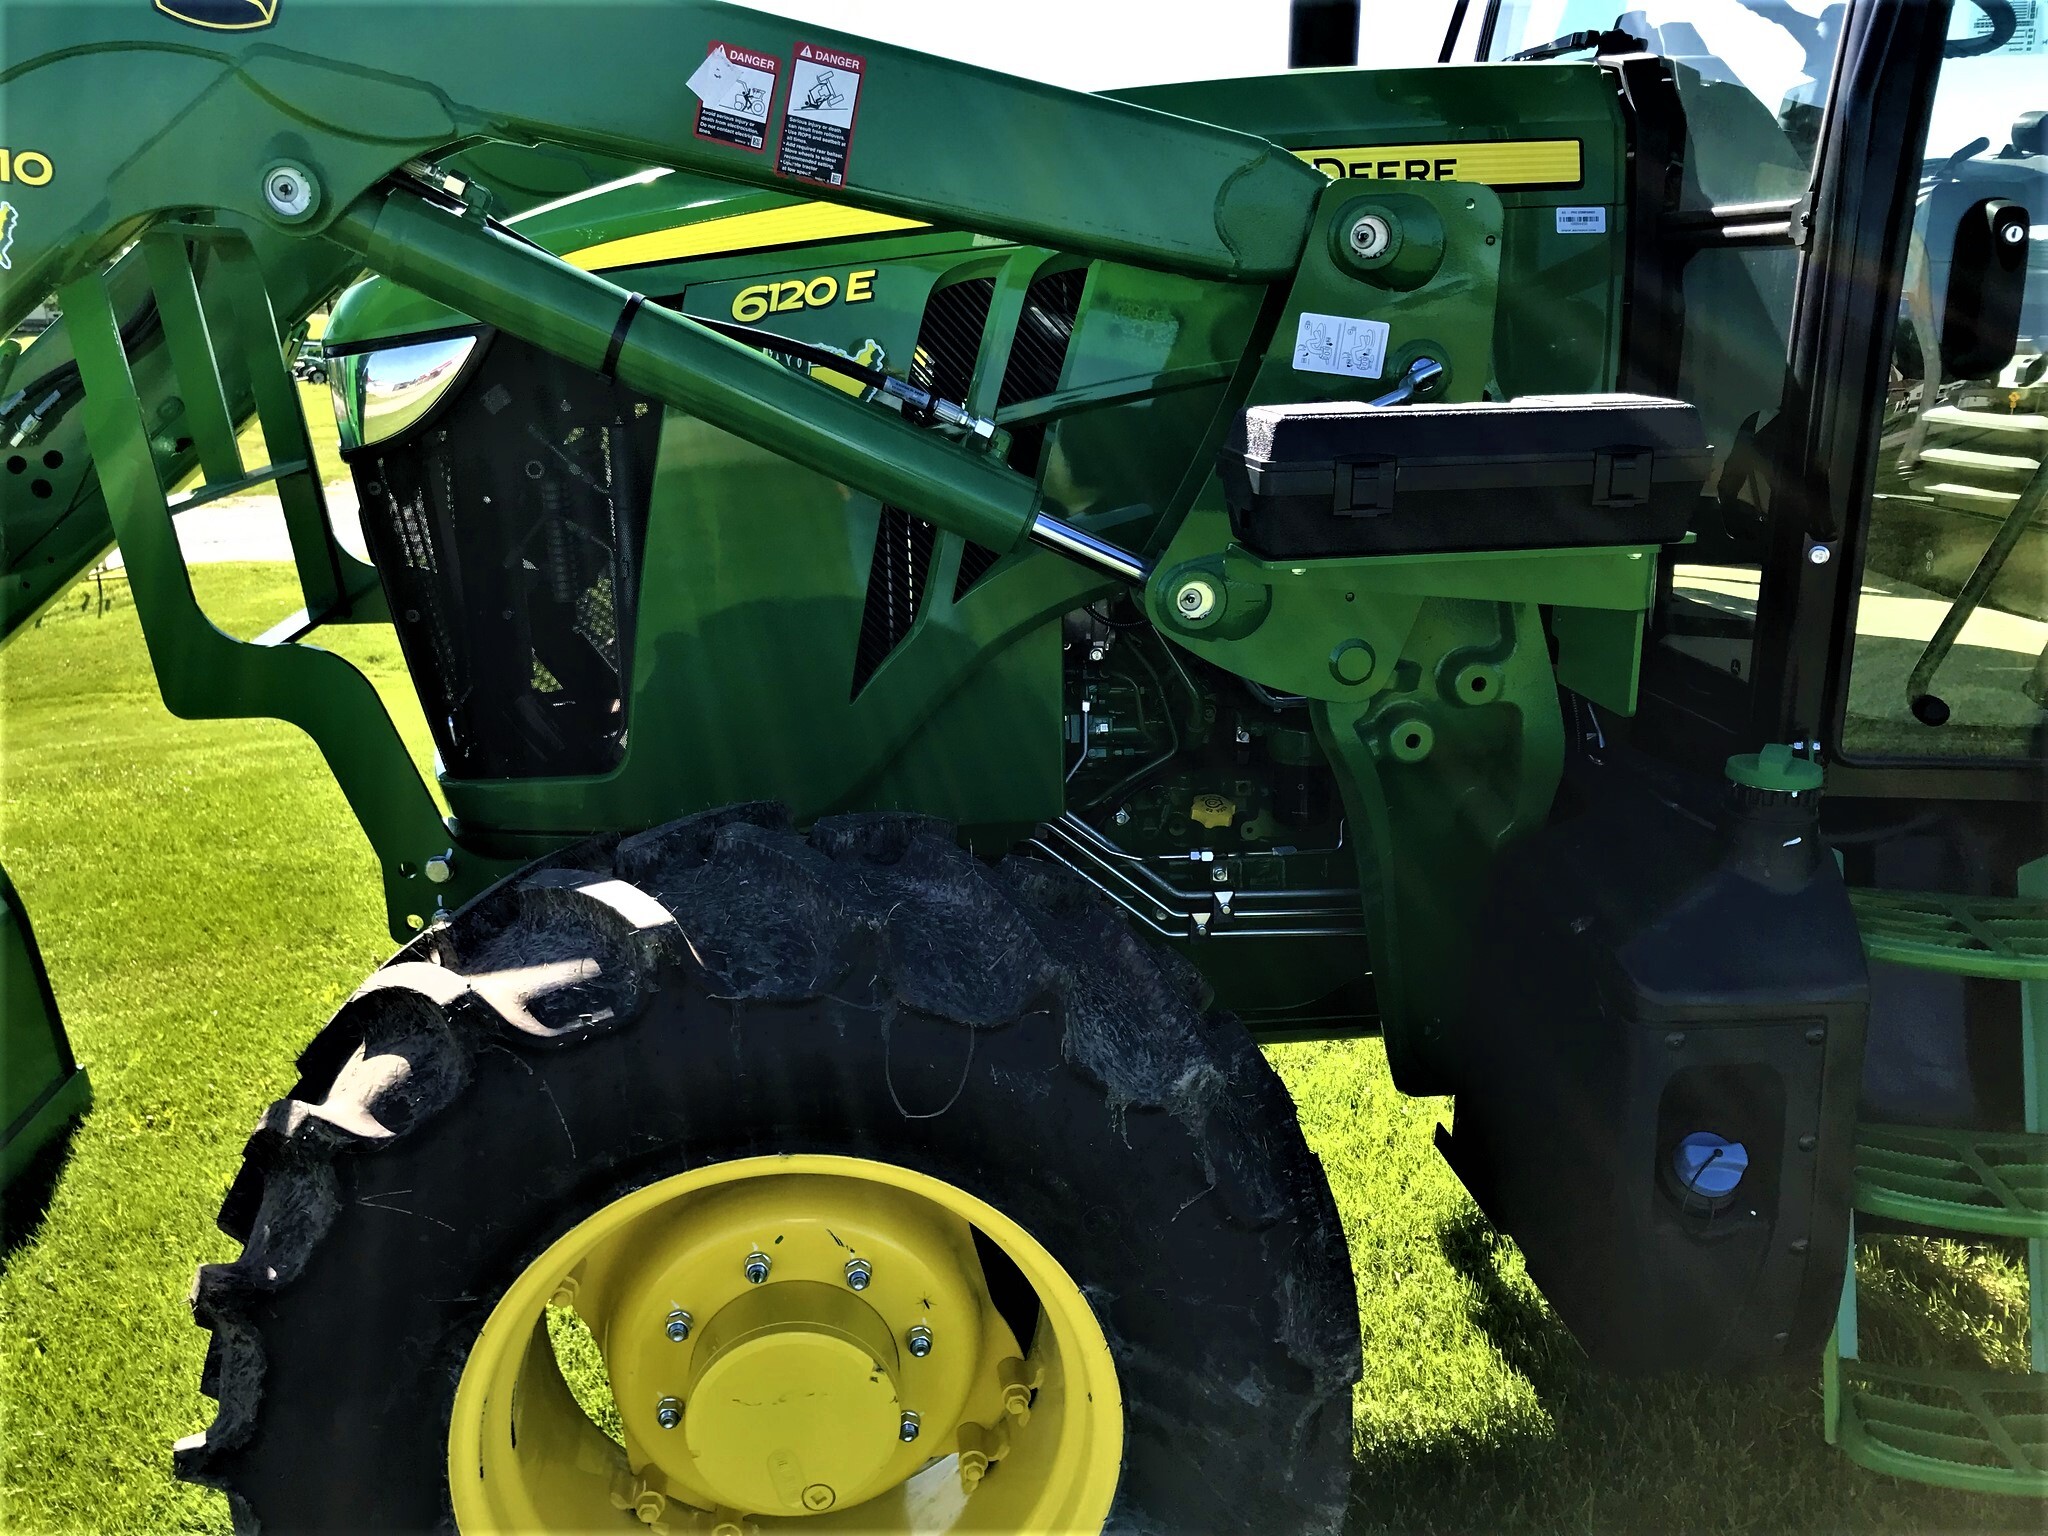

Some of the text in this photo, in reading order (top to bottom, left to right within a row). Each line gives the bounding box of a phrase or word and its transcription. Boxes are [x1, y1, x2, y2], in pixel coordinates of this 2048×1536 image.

[730, 50, 775, 70] DANGER
[816, 51, 860, 70] DANGER
[731, 269, 877, 322] 6120 E
